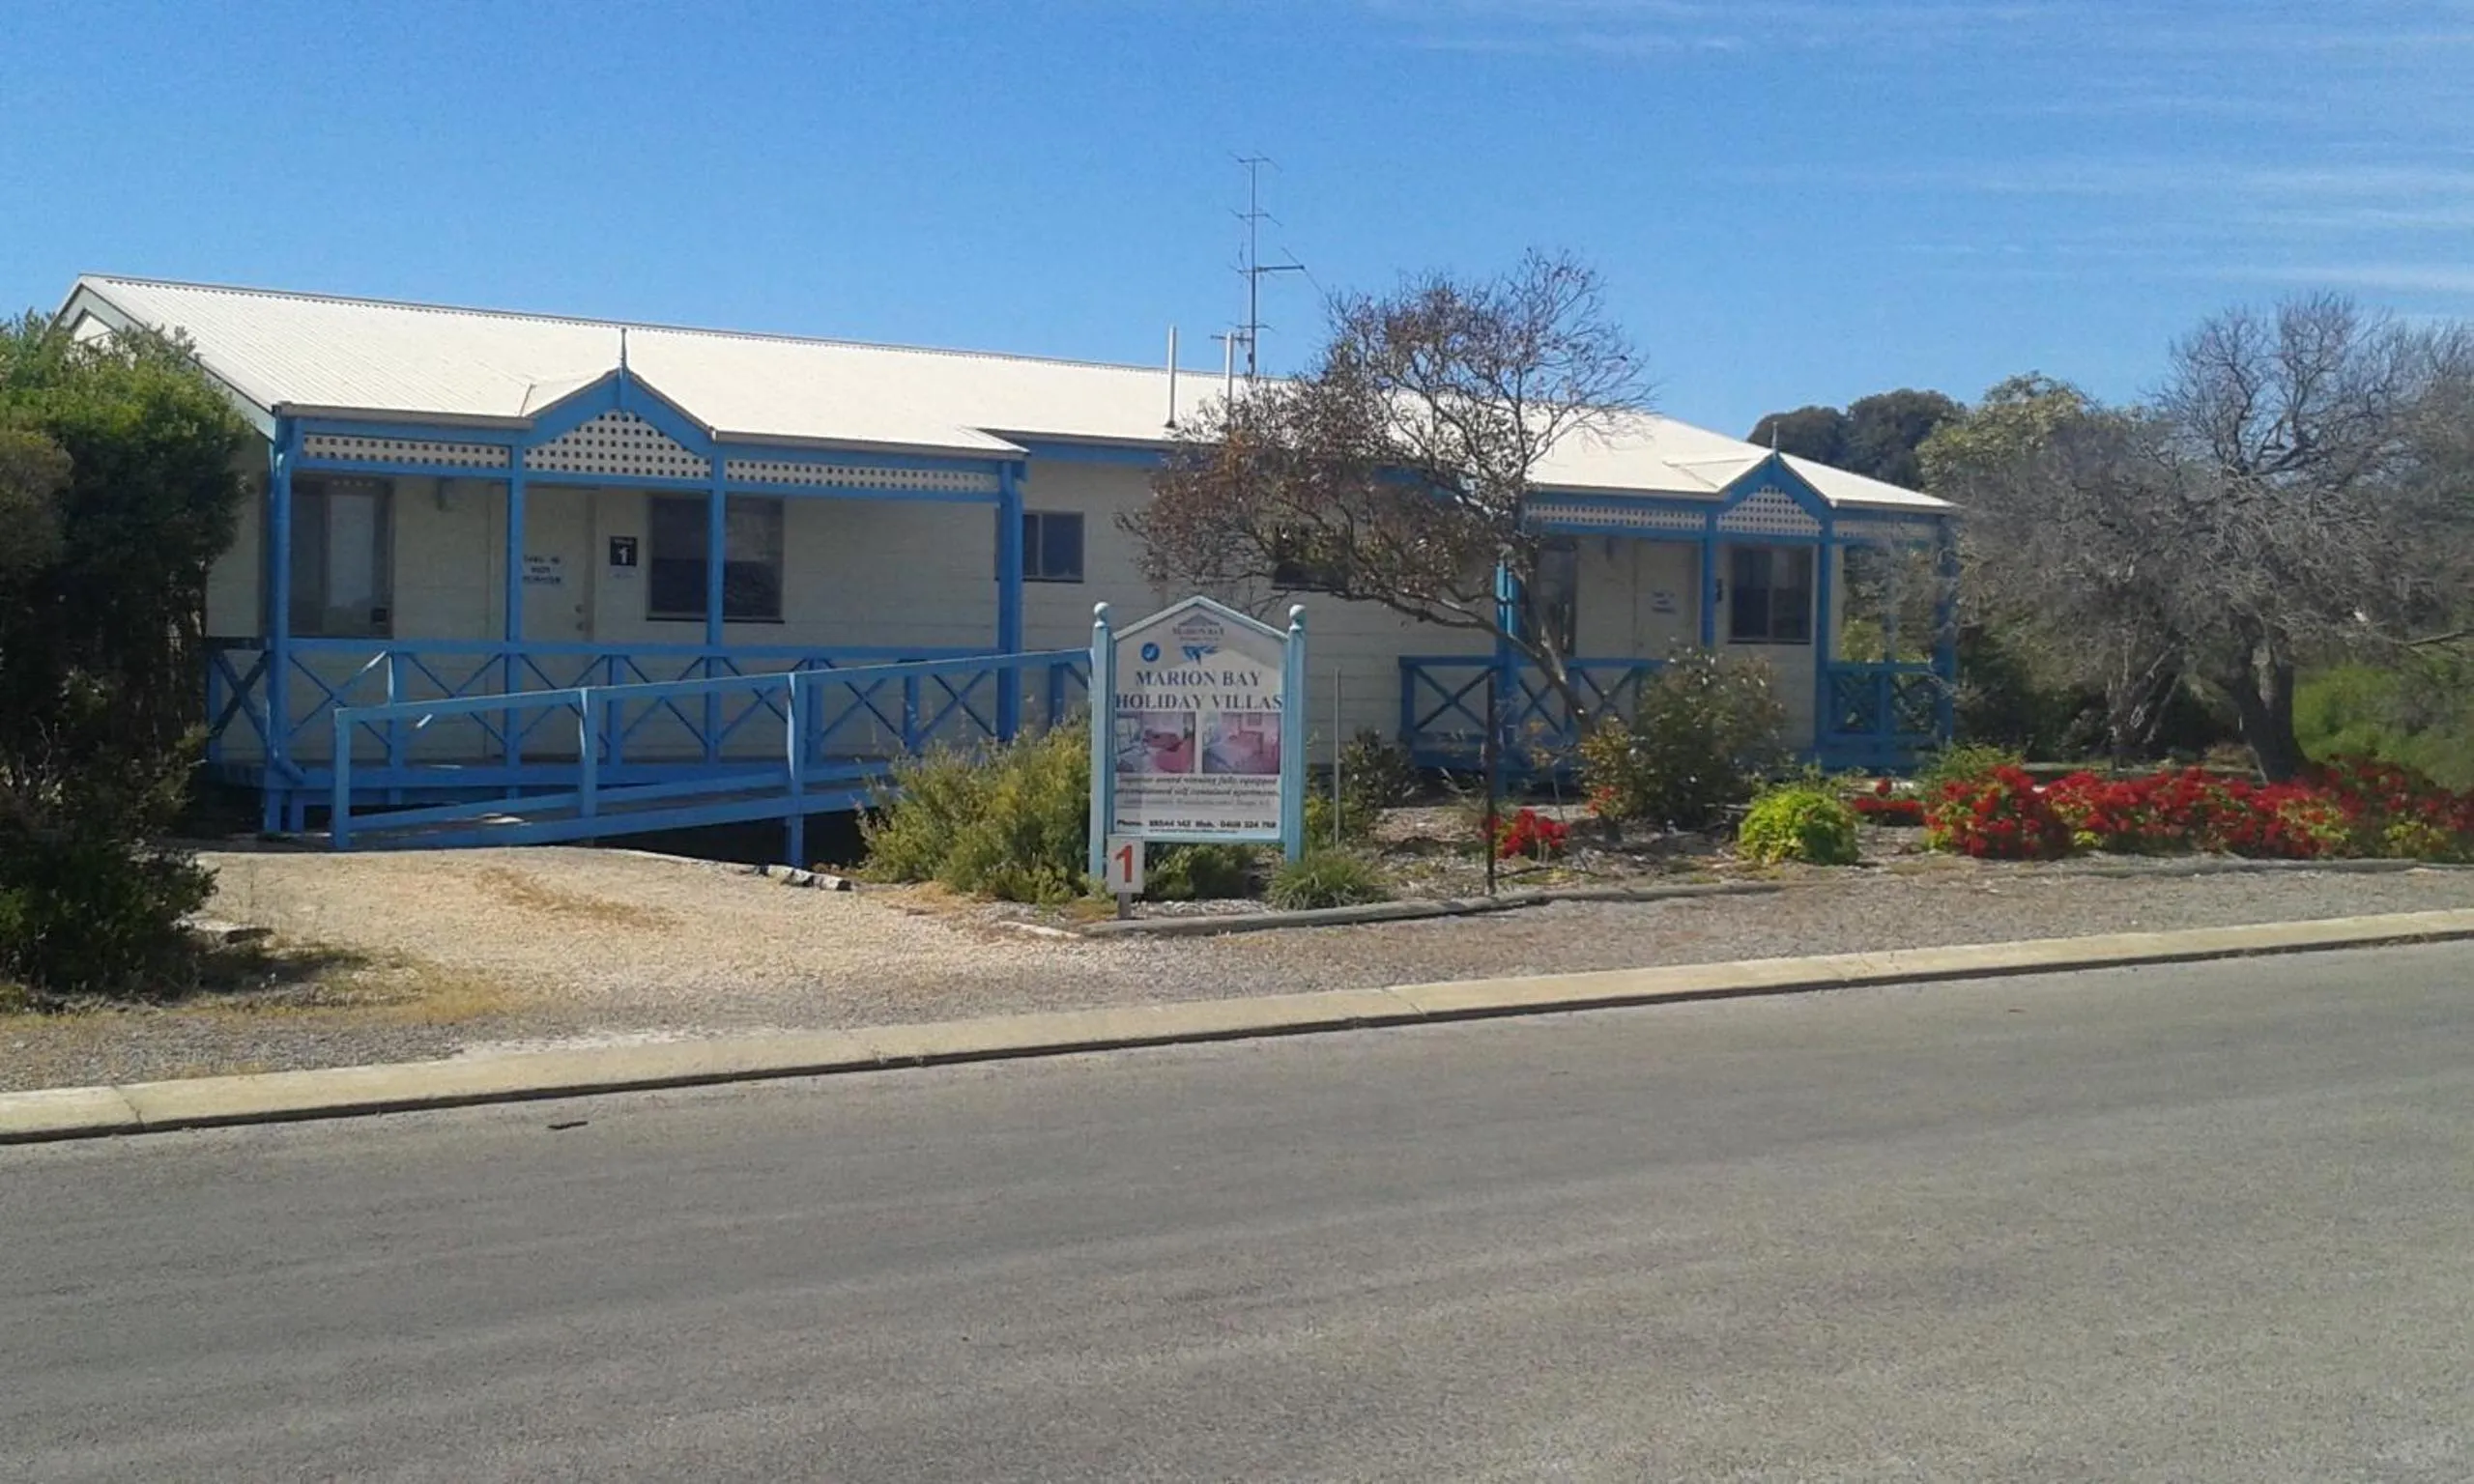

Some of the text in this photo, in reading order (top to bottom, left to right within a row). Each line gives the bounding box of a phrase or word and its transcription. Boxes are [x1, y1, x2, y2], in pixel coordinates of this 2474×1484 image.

[618, 546, 627, 564] 1
[1136, 671, 1261, 687] MARION BAY
[1115, 694, 1283, 710] HOLIDAY VILLAS
[1115, 843, 1133, 883] 1
